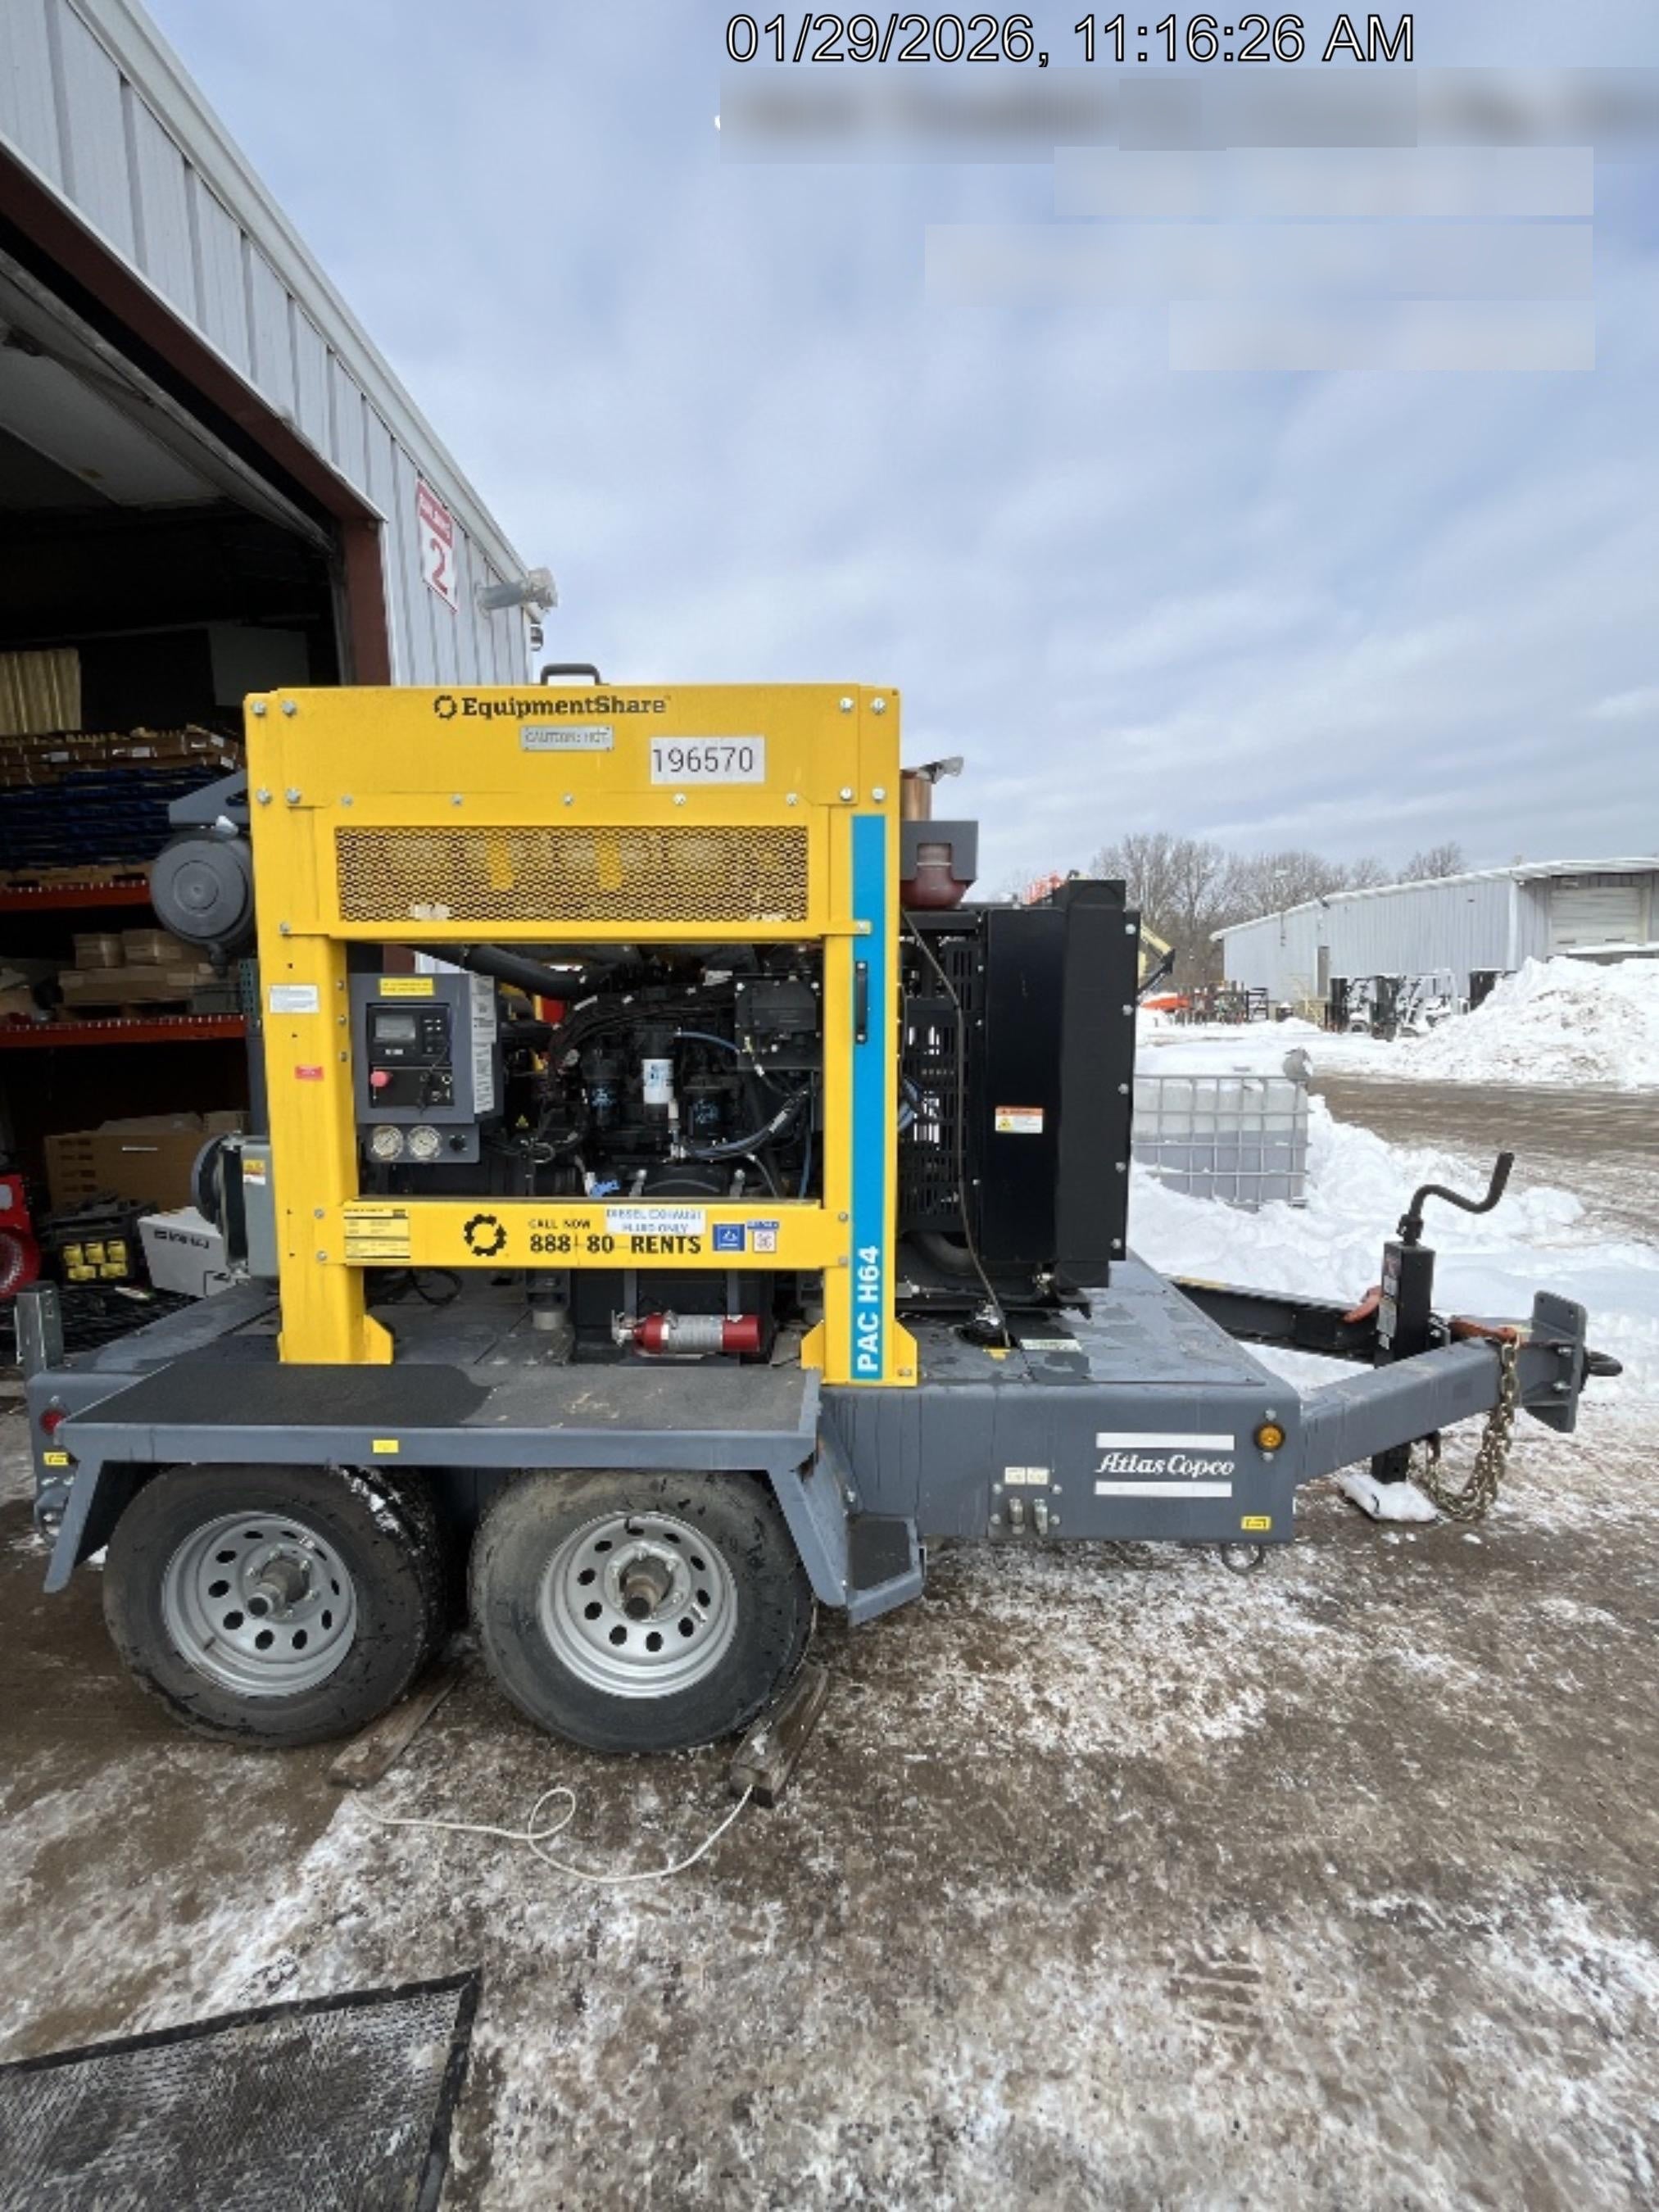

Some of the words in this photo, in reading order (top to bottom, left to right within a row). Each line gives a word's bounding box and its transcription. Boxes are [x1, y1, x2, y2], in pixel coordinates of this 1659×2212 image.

[430, 537, 446, 595] 2
[461, 695, 666, 718] EquipmentShare
[652, 746, 755, 773] 196570
[528, 1218, 558, 1230] CALL
[563, 1218, 591, 1230] NOW
[857, 1244, 880, 1303] H64
[857, 1311, 879, 1372] PAC
[1095, 1452, 1167, 1474] Atlas
[1167, 1453, 1235, 1479] Copco
